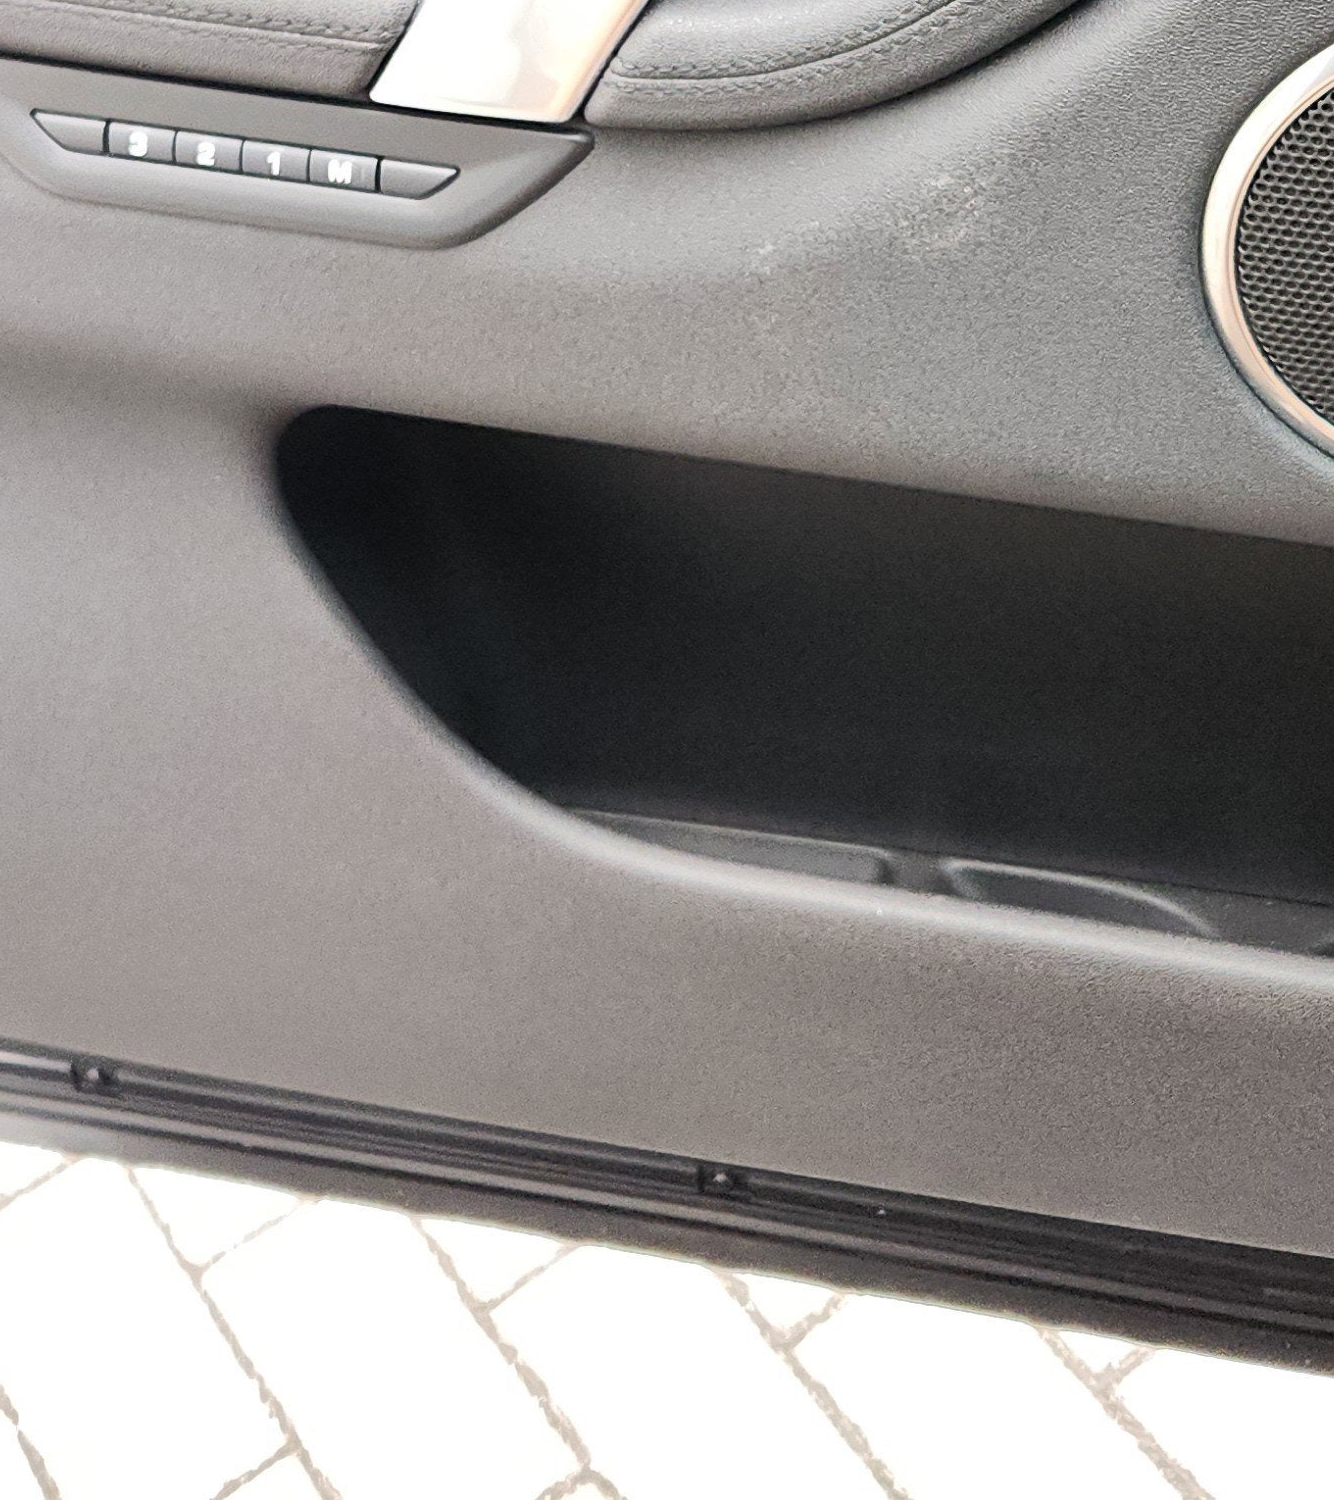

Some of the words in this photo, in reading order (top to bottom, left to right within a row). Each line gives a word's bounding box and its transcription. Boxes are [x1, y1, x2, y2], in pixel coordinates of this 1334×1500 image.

[128, 131, 149, 157] 3
[196, 142, 216, 167] 2
[266, 151, 282, 175] 1
[327, 159, 353, 185] M
